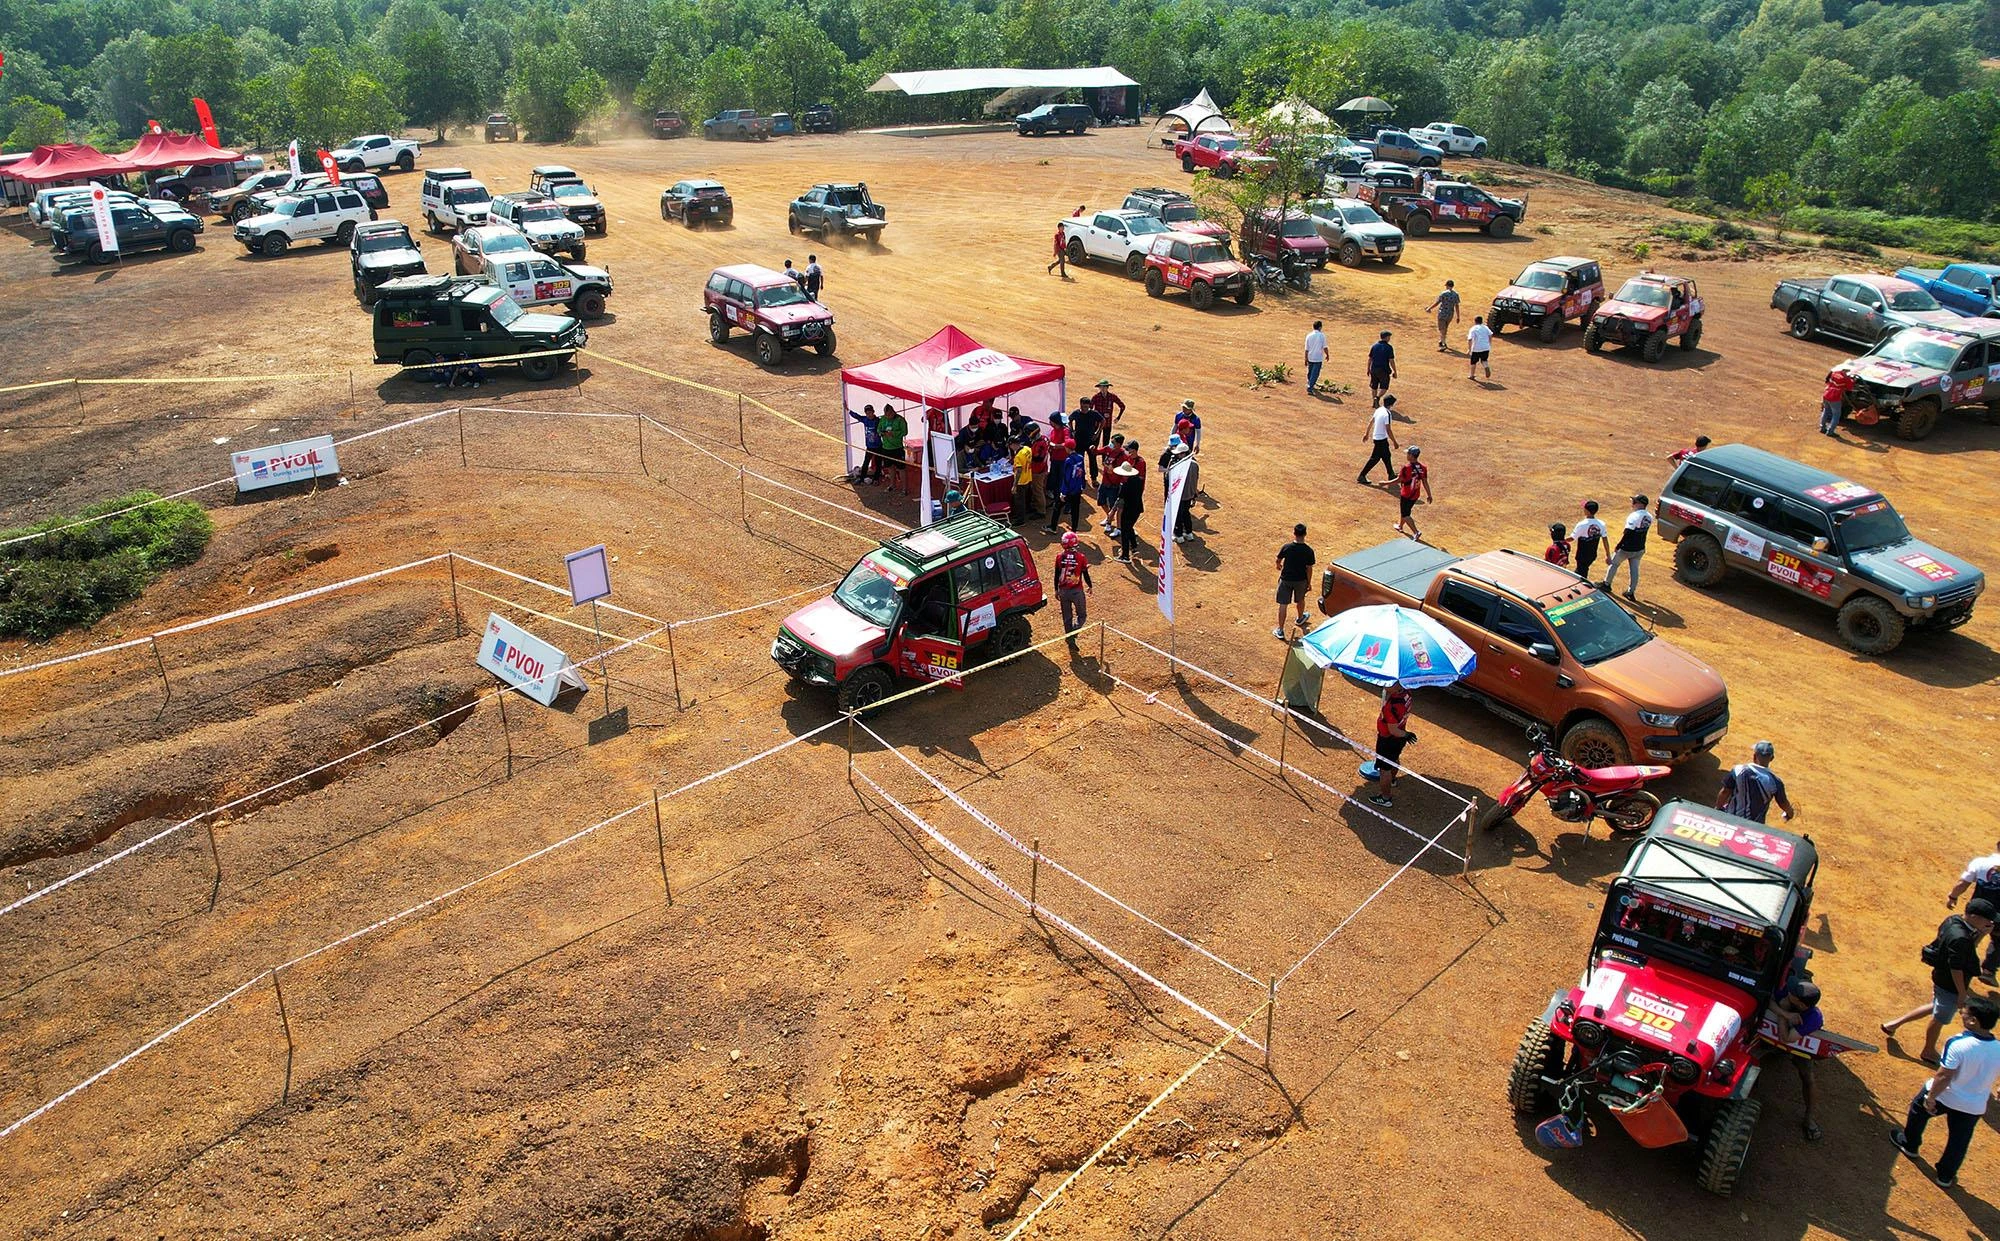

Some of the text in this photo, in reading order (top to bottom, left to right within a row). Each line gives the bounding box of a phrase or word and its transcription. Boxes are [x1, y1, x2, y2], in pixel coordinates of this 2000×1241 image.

[553, 281, 570, 289] 309
[961, 354, 1006, 372] PVOIL
[270, 451, 322, 471] PVOIL
[1775, 552, 1801, 570] 314
[1770, 563, 1798, 581] PVOIL
[506, 645, 545, 683] PVOIL
[931, 653, 957, 668] 318
[1673, 825, 1725, 847] 310
[1738, 925, 1765, 938] 310
[1631, 995, 1676, 1017] PVOIL
[1623, 1005, 1676, 1031] 310
